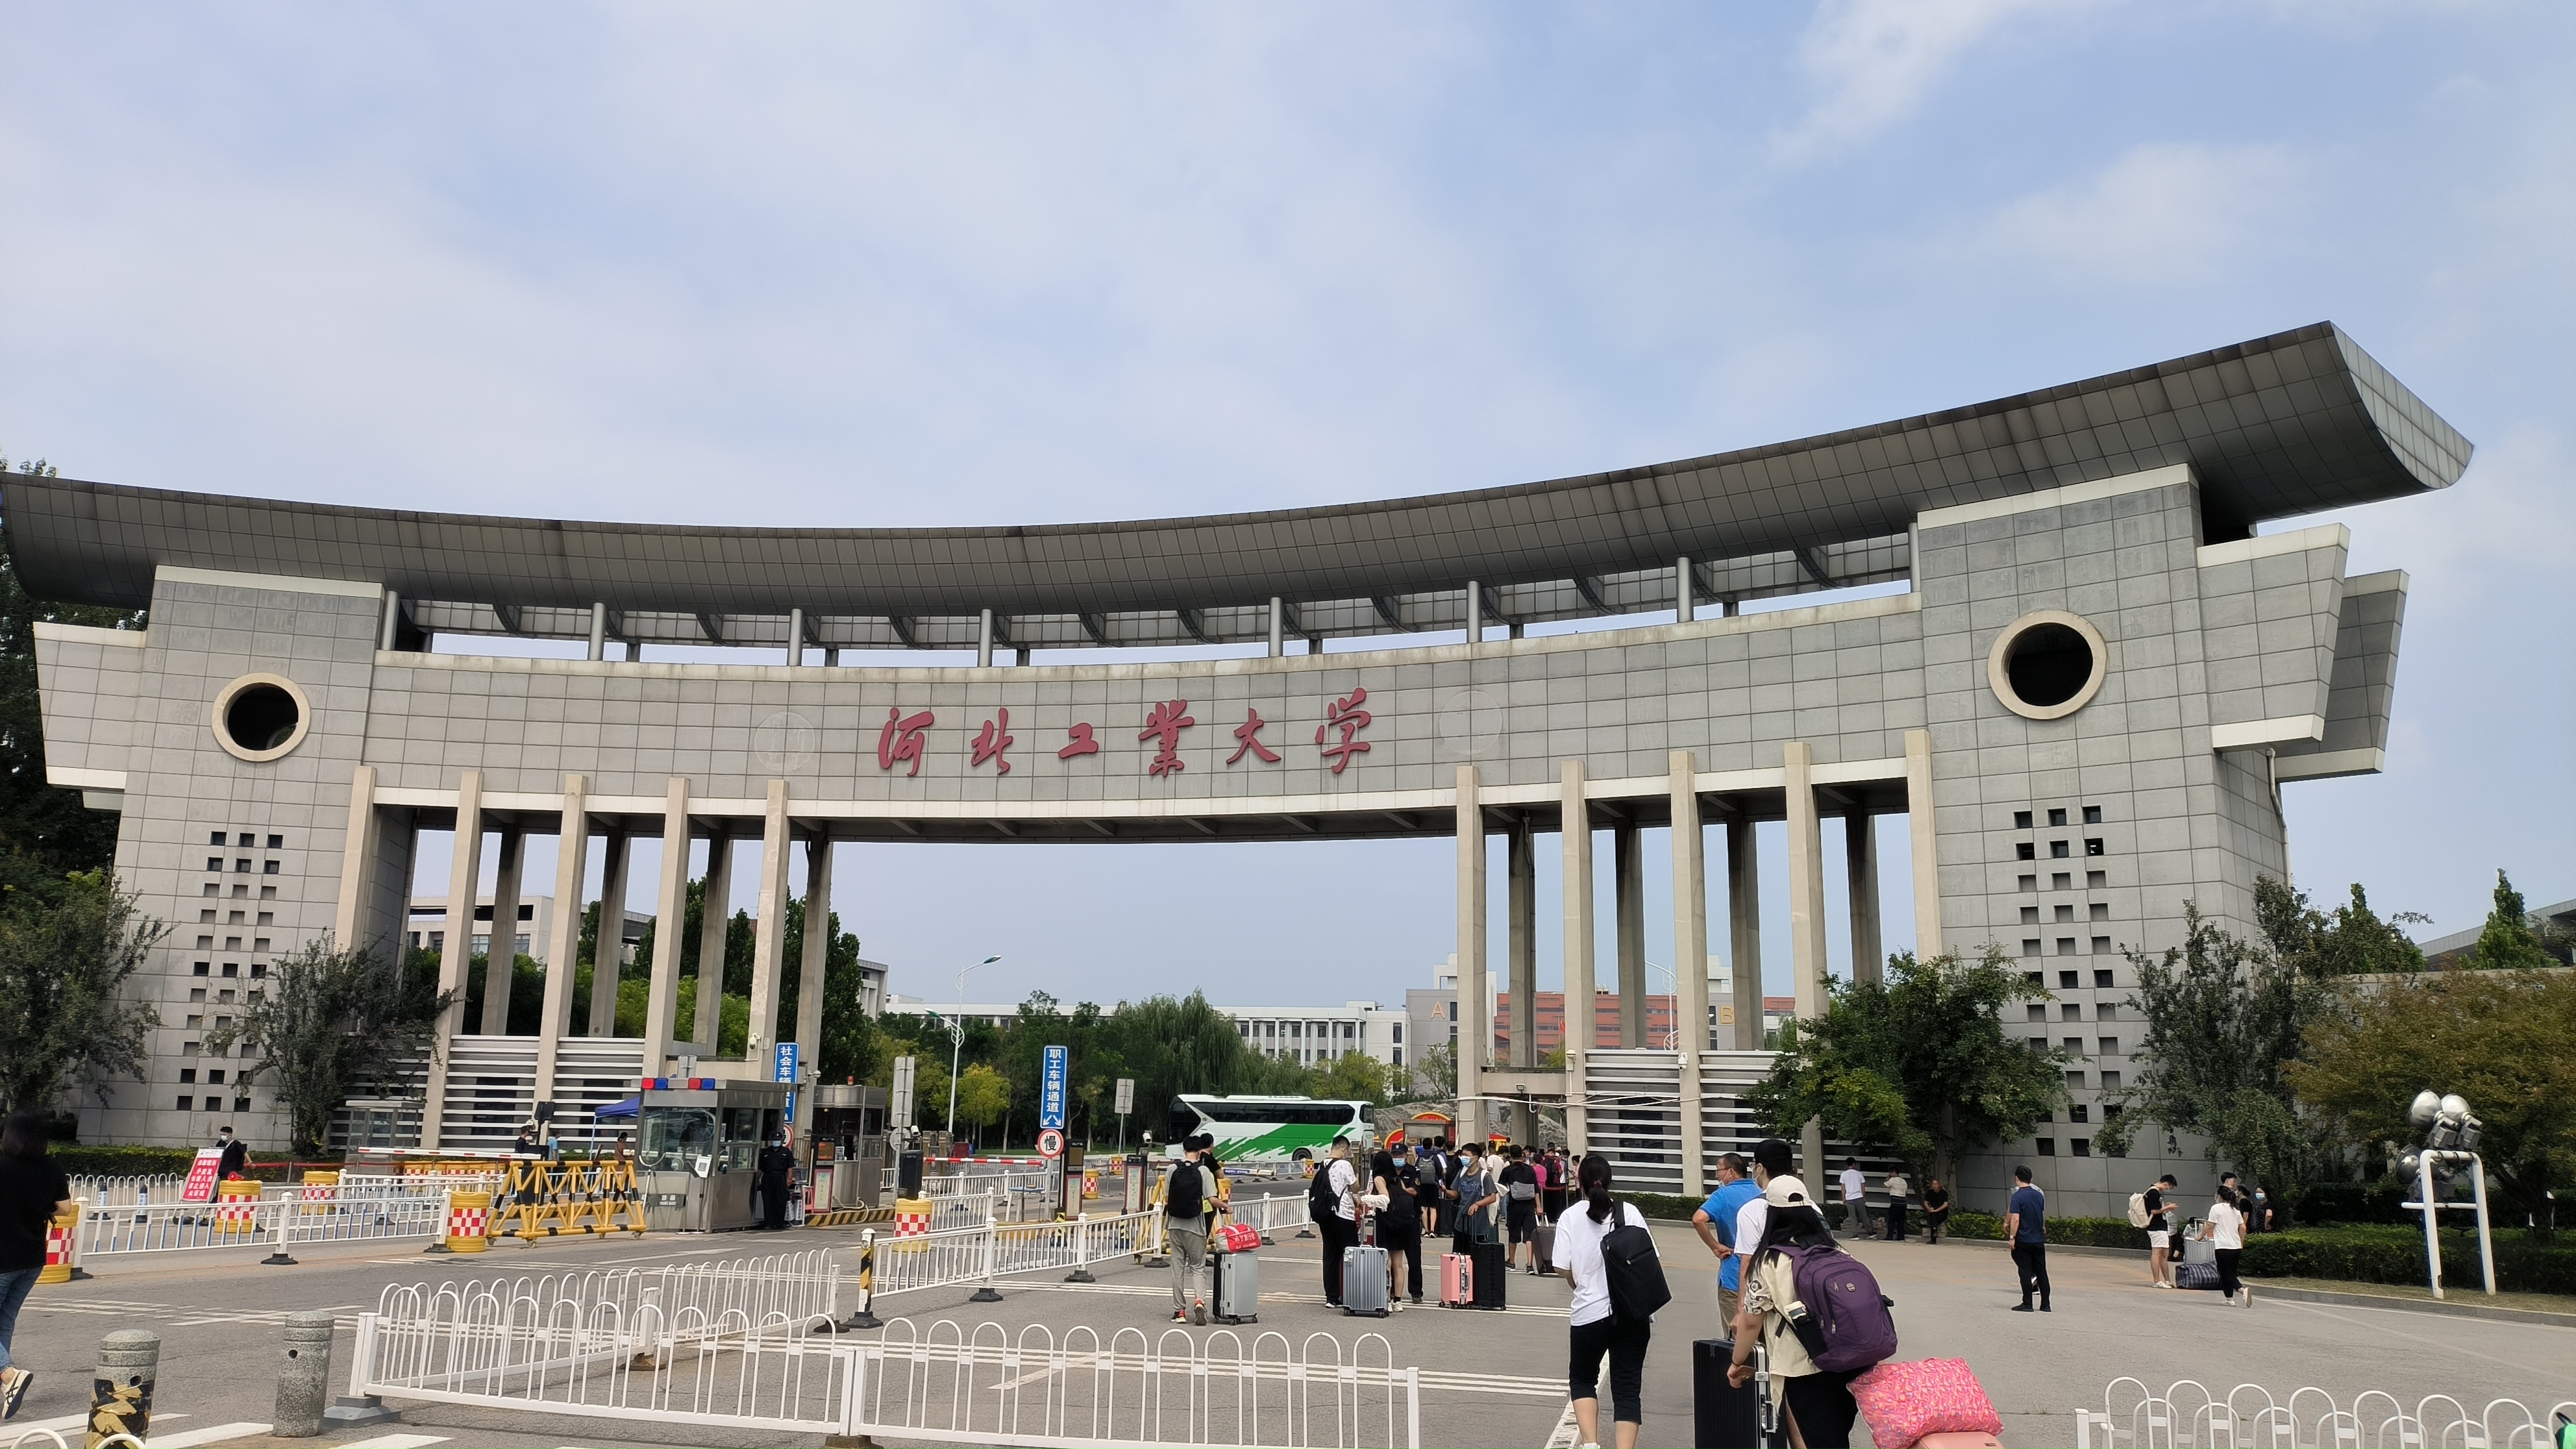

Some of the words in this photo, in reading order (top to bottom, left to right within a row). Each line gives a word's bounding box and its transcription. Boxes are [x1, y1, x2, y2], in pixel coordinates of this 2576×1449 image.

[1430, 1001, 1446, 1019] A
[1720, 1006, 1735, 1024] B
[778, 1046, 793, 1108] 社会车辆
[1046, 1048, 1061, 1113] 职工车辆通道
[1045, 1135, 1056, 1151] 慢
